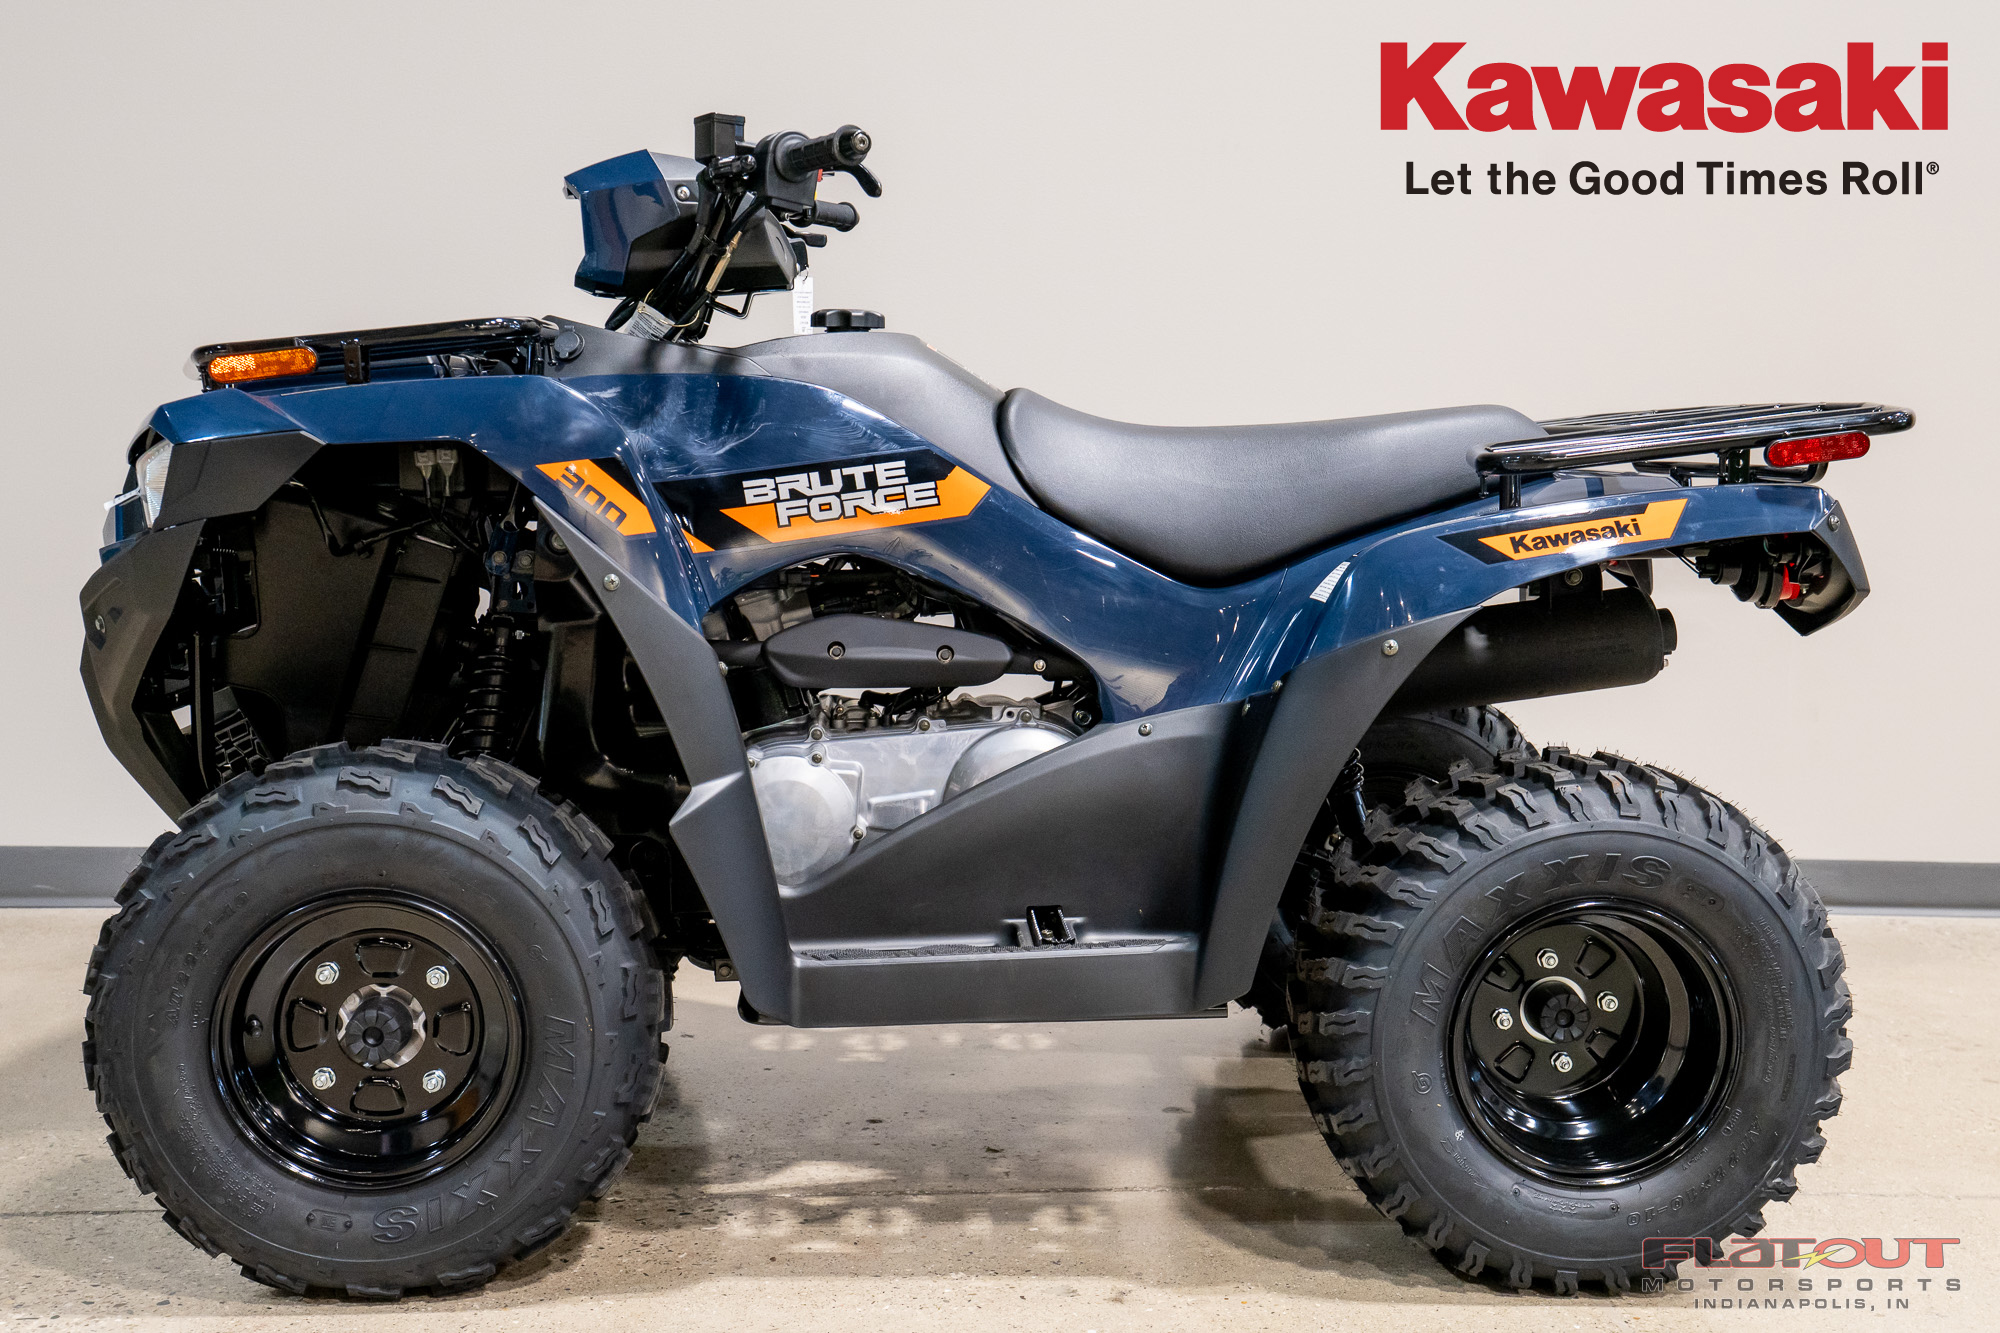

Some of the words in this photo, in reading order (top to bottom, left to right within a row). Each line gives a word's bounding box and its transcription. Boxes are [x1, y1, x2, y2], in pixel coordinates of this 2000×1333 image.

[556, 466, 627, 532] 300
[741, 460, 909, 505] BRUTE
[776, 480, 941, 528] FORCE
[1509, 518, 1642, 554] Kawasaki
[1410, 852, 1672, 1026] MAXXIS
[371, 1014, 576, 1243] MAXXIS
